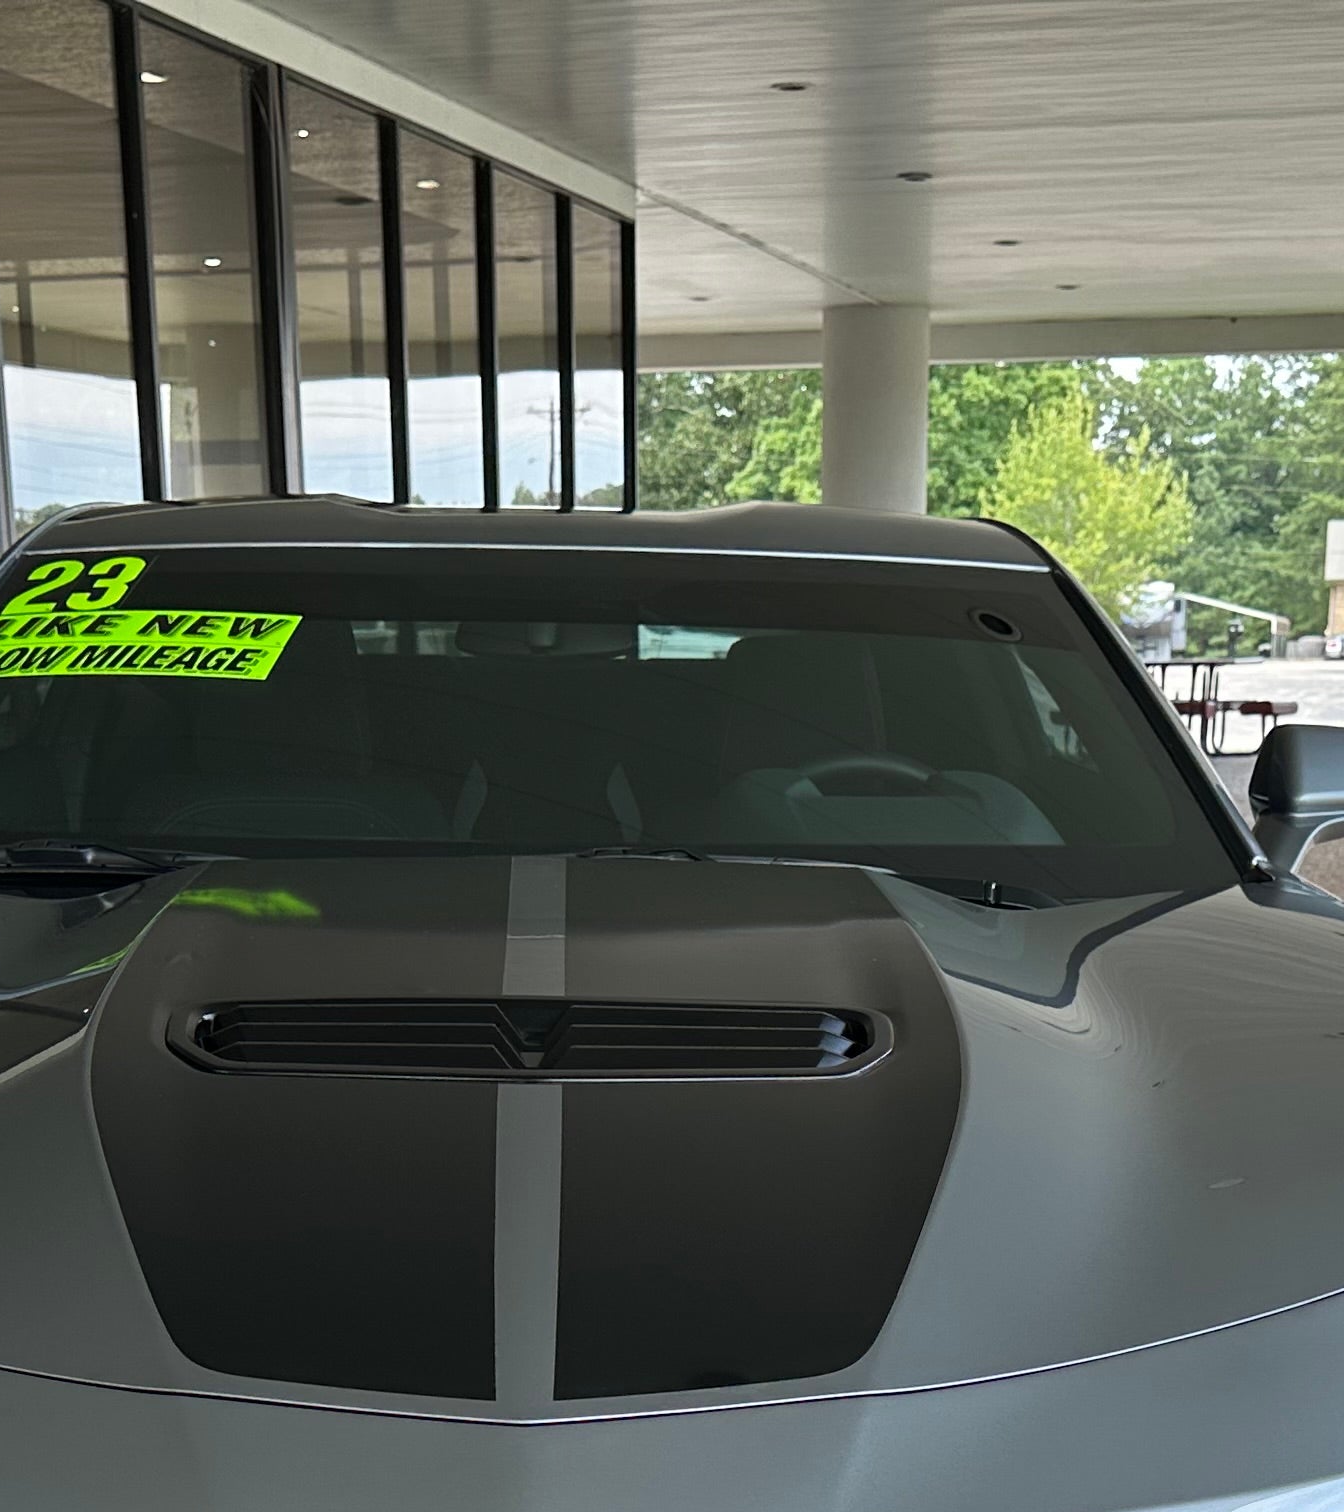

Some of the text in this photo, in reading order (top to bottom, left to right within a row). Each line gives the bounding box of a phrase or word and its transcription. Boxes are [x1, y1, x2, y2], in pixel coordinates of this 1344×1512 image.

[1, 556, 147, 614] 23
[137, 615, 290, 642] NEW
[67, 646, 269, 676] MILEAGE
